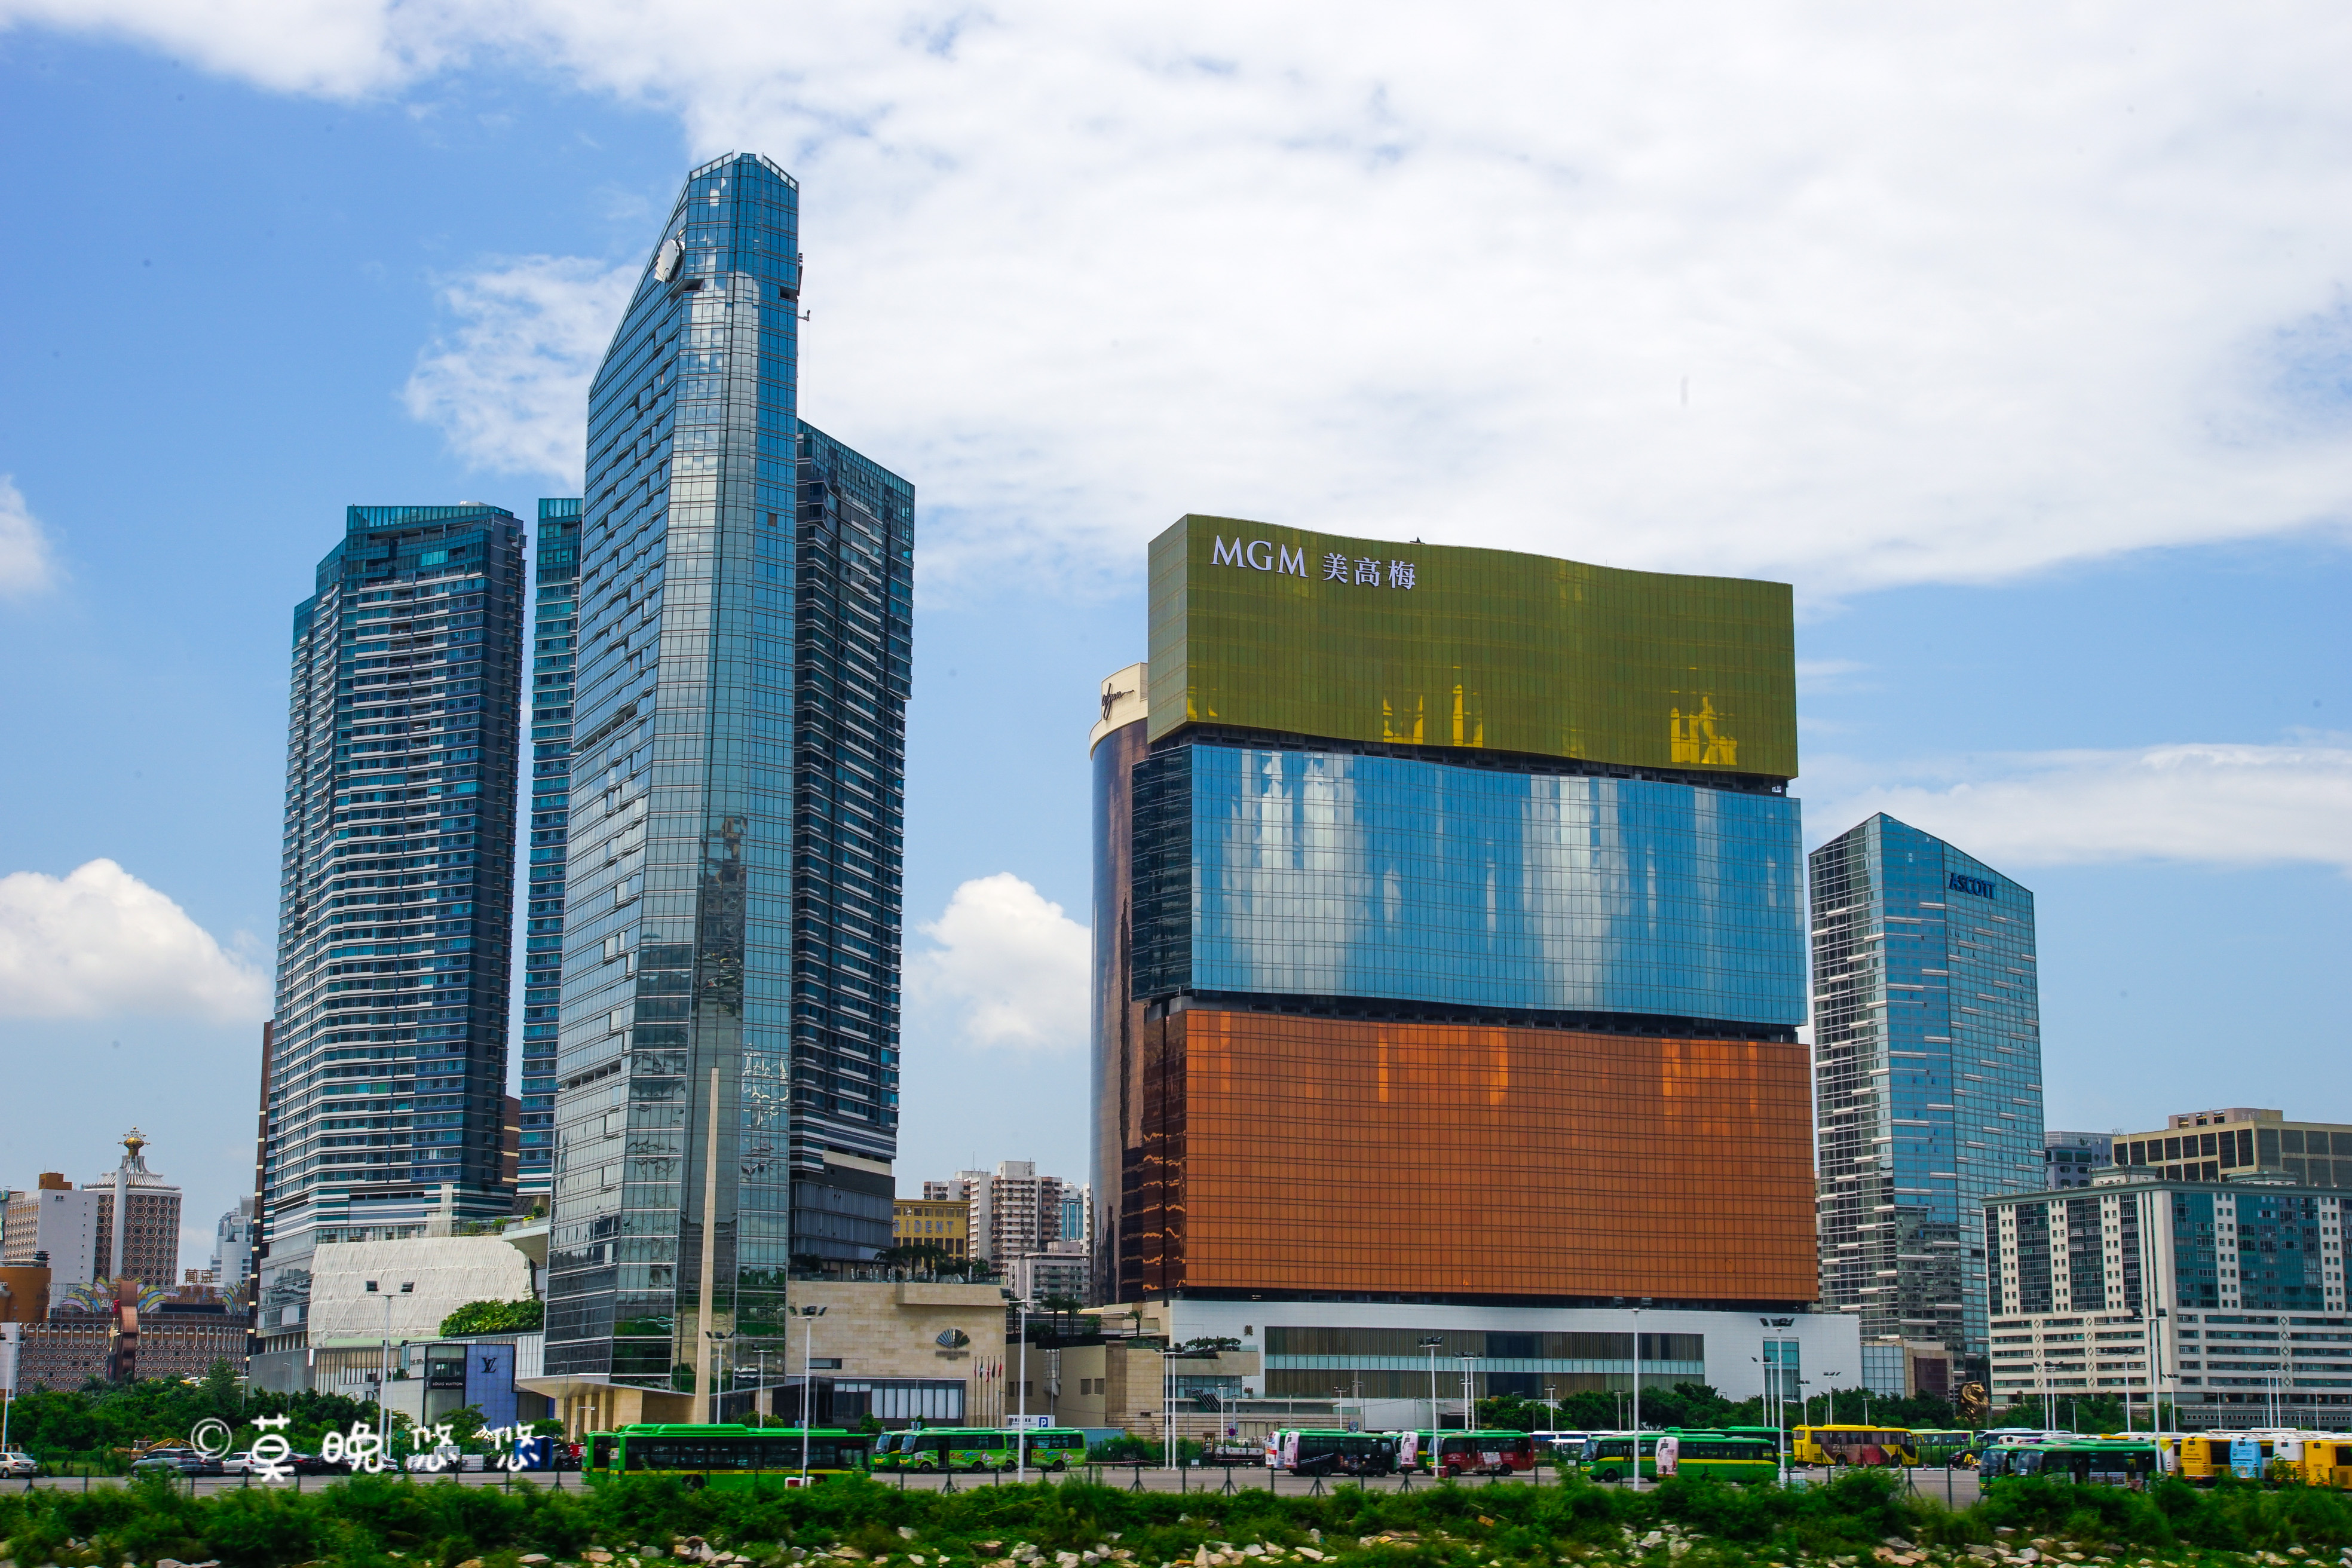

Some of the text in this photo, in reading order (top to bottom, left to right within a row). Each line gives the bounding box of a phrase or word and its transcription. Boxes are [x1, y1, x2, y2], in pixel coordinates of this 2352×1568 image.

[1210, 535, 1416, 590] MGM 美高梅
[1949, 872, 1996, 899] ASCOTT
[185, 1269, 215, 1284] 葡京
